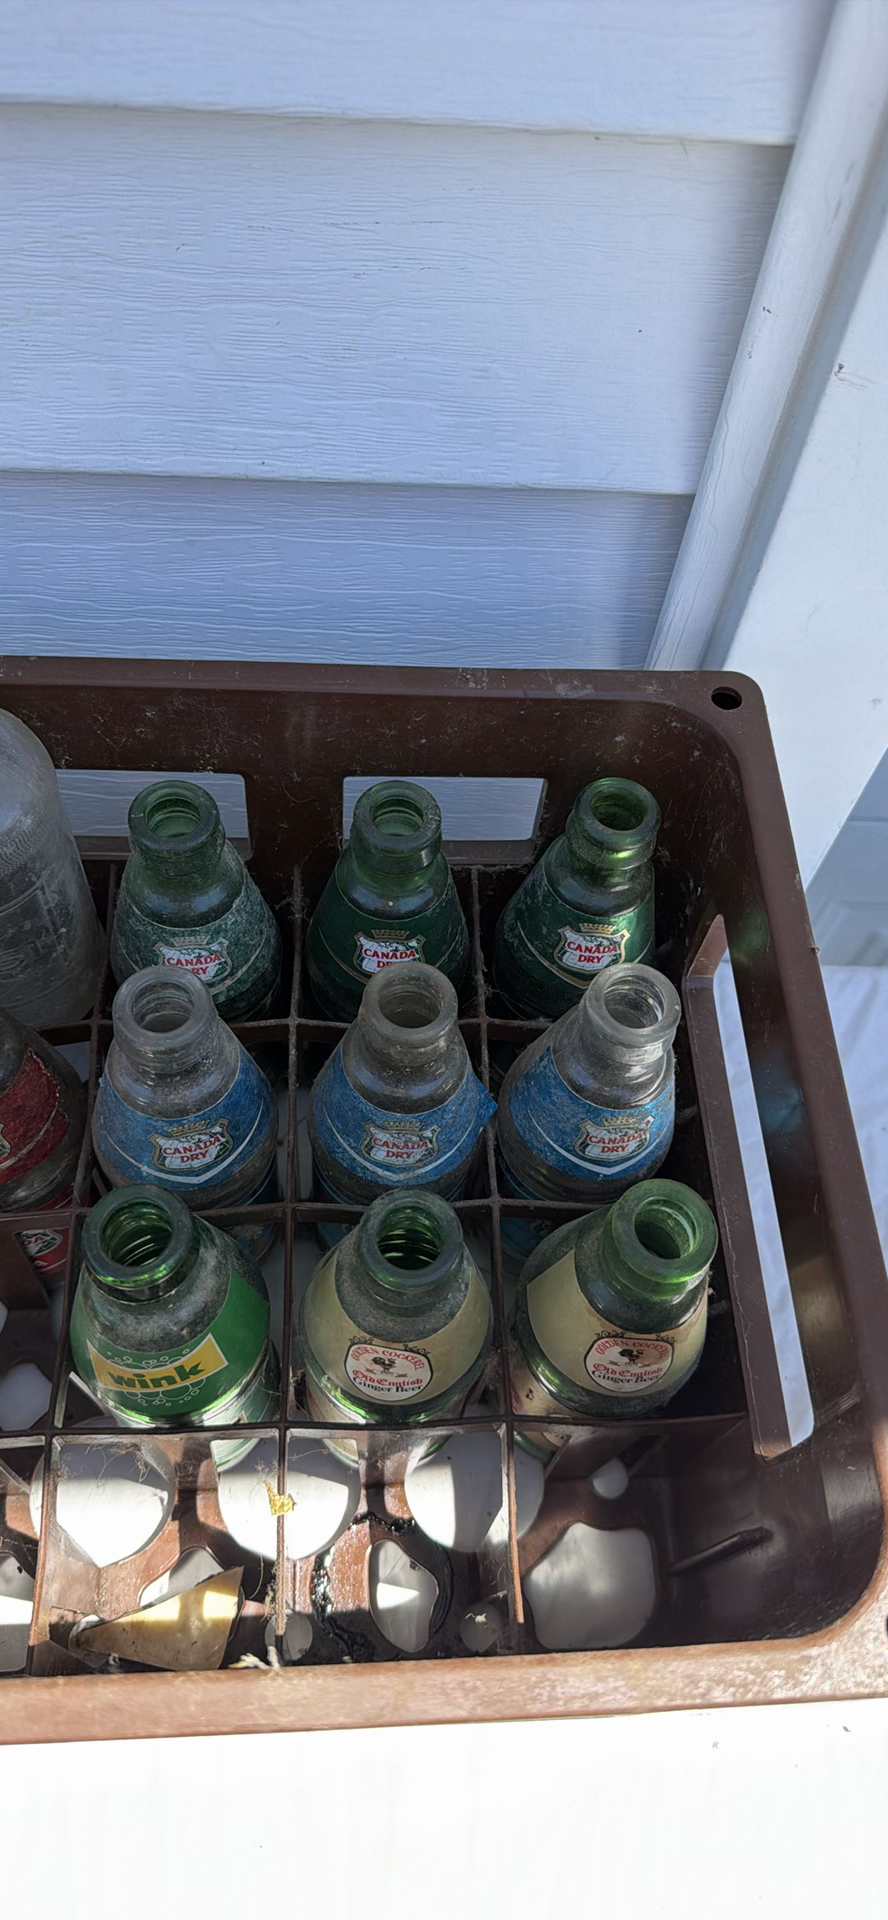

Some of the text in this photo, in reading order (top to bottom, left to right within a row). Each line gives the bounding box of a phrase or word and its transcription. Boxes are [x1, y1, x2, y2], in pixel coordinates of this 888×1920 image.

[363, 948, 416, 960] CANADA
[566, 941, 618, 954] CANADA
[166, 953, 221, 966] CANADA
[577, 954, 604, 964] DRY
[191, 966, 209, 975] RY
[372, 1138, 429, 1150] CANADA
[588, 1131, 643, 1144] CANADA
[162, 1136, 222, 1155] CANADA
[601, 1144, 629, 1153] DRY
[180, 1149, 209, 1163] DRY
[386, 1150, 414, 1159] DRY
[594, 1340, 629, 1355] GOLDEN
[350, 1346, 425, 1371] GOLDEN COCKEREL
[107, 1361, 206, 1389] wink
[591, 1369, 662, 1384] Ginger Beer
[593, 1363, 617, 1375] Old
[618, 1367, 663, 1378] English
[352, 1369, 376, 1383] Old
[376, 1378, 423, 1388] English
[353, 1376, 423, 1393] Ginger Beer
